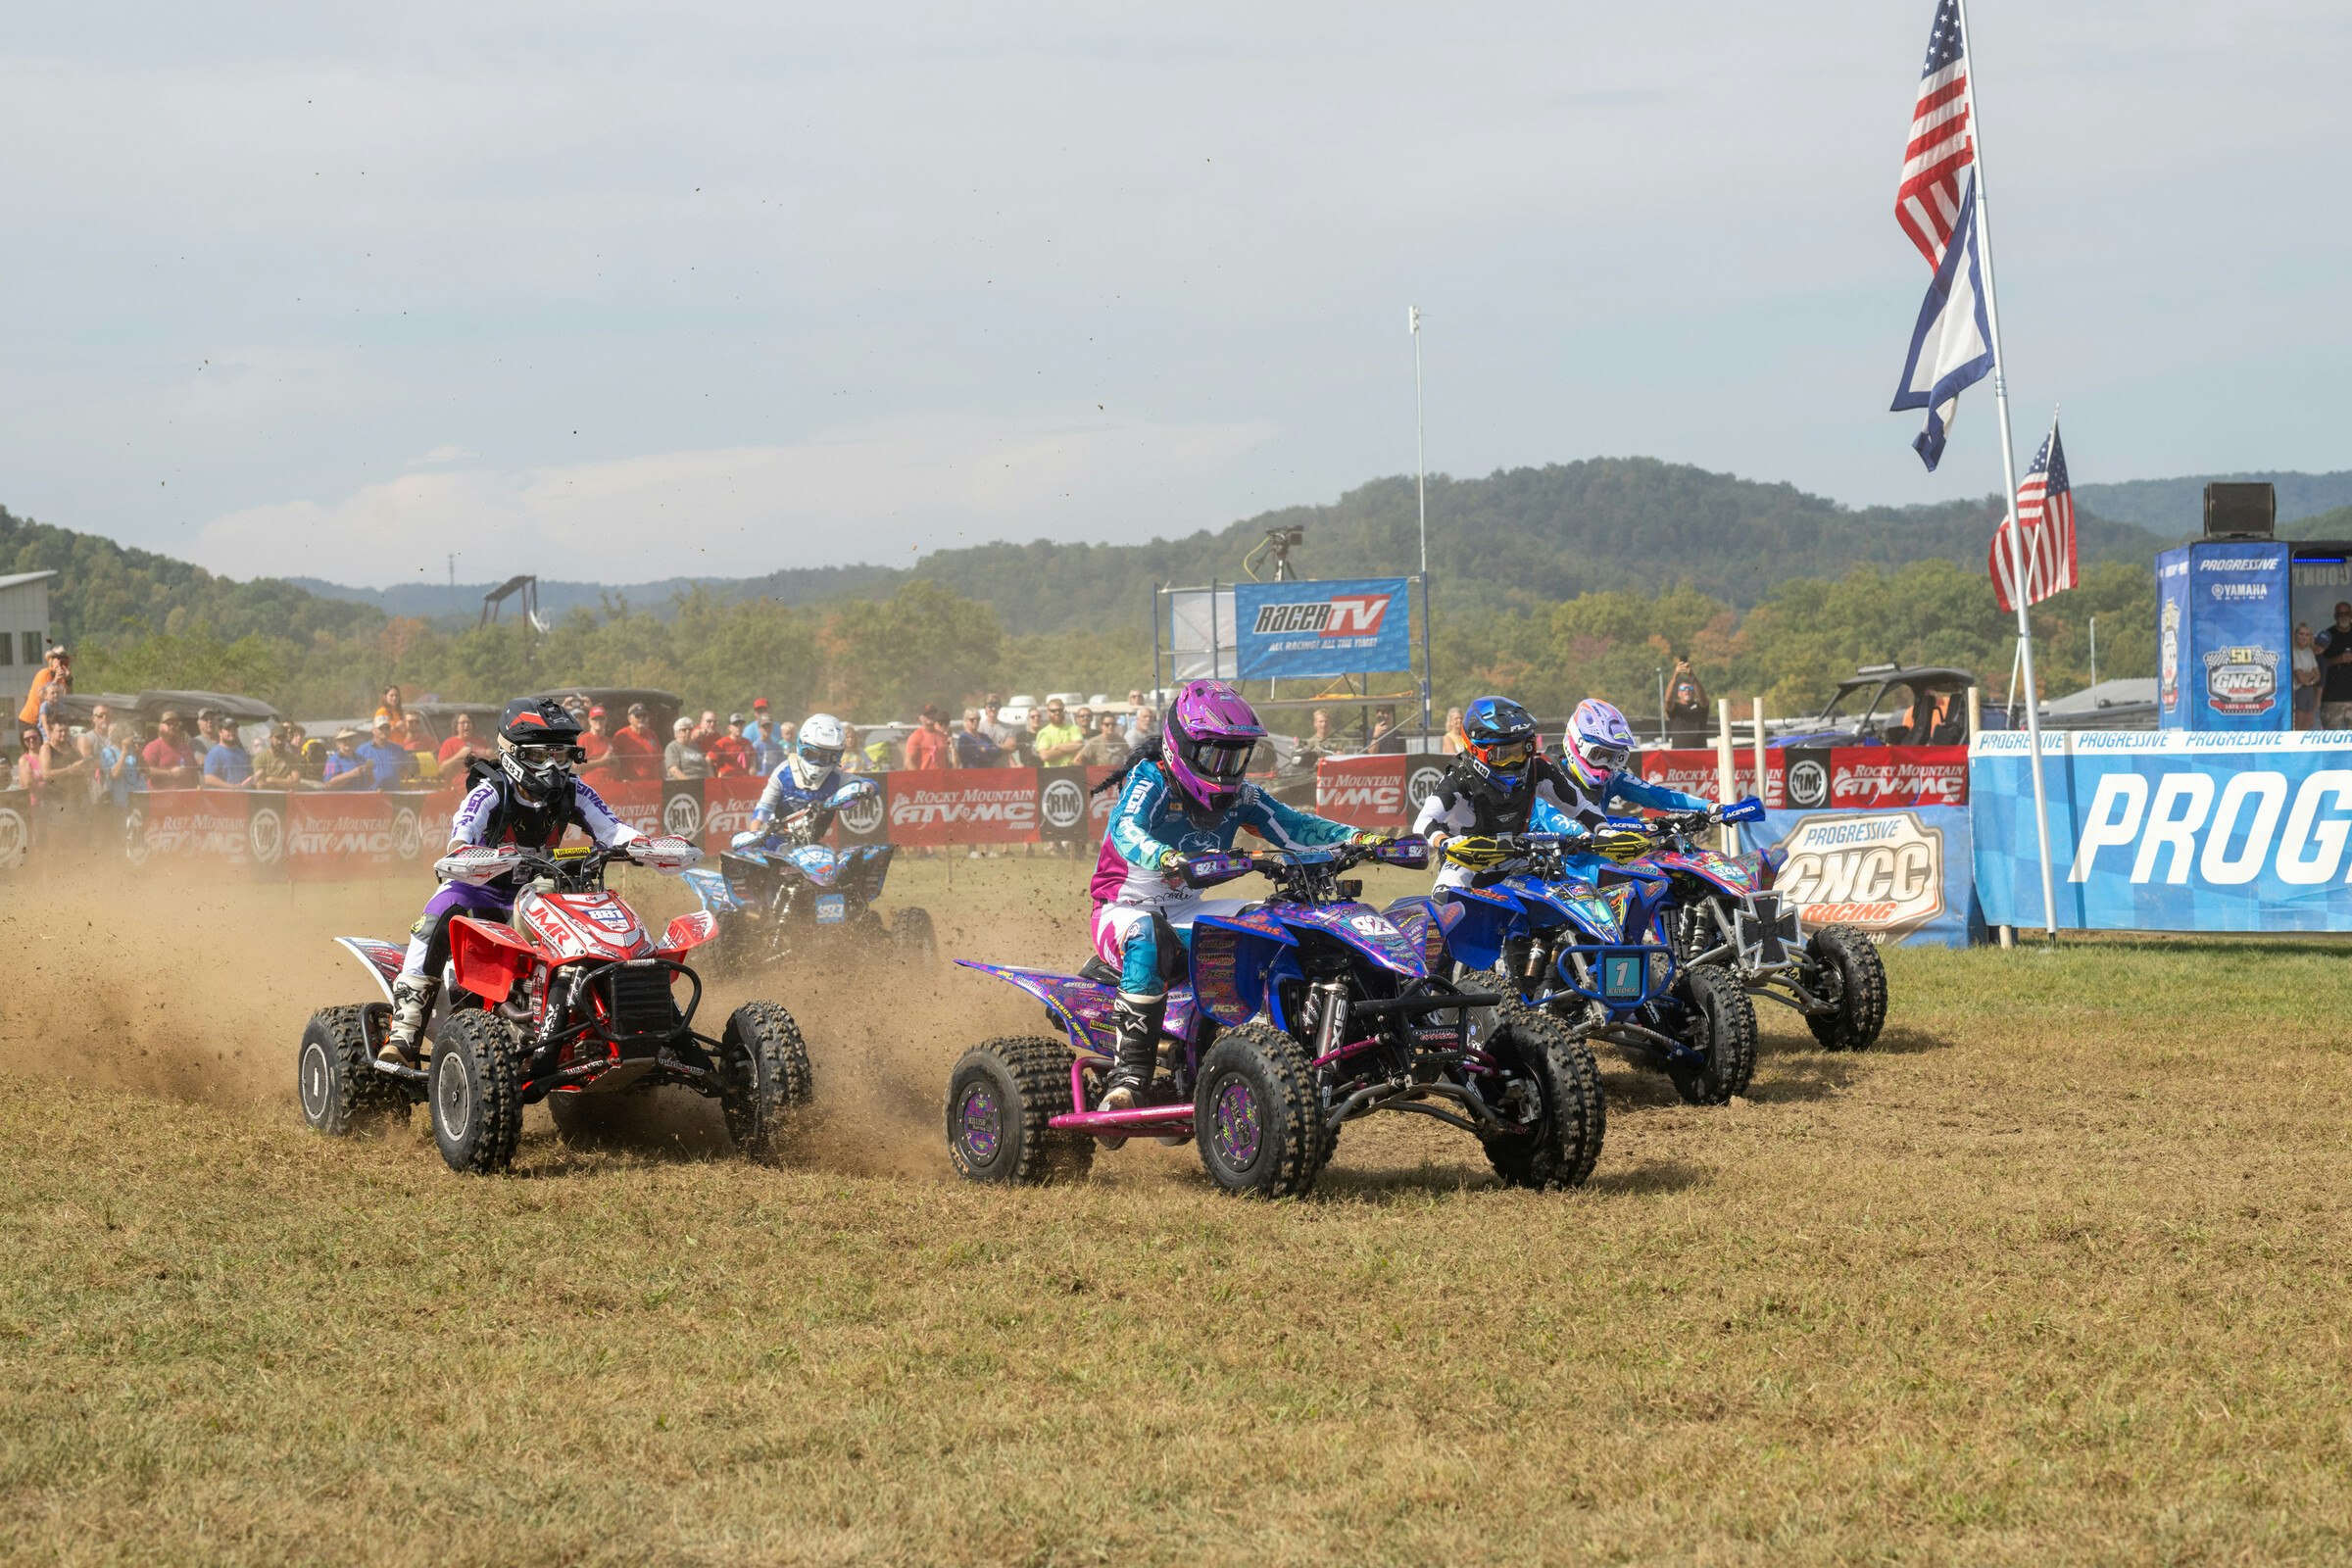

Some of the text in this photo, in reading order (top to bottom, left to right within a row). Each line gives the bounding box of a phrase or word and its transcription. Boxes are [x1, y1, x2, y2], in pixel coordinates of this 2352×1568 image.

[2200, 558, 2278, 571] PROGRESSIVE
[2225, 584, 2268, 596] YAMAHA
[1327, 599, 1390, 631] TV
[1269, 642, 1283, 652] ALL
[1286, 640, 1320, 651] RACING!
[1321, 640, 1336, 650] ALL
[1338, 639, 1351, 648] THE
[2230, 648, 2252, 663] 50
[2214, 673, 2270, 688] GNCC
[1510, 723, 1532, 732] FLY
[1980, 732, 2063, 750] PROGREIVE
[2079, 732, 2169, 749] PROGRESSIVE
[2185, 731, 2283, 748] PROGRESSIVE
[1667, 768, 1707, 781] ROCKY
[1852, 765, 1965, 778] ROCKY MOUNTAIN
[1335, 775, 1402, 788] MOUNTAIN
[914, 789, 1035, 803] ROCKY MOUNTAIN
[1804, 819, 1901, 847] PROGRESSIVE
[2067, 771, 2352, 885] PROG
[1619, 863, 1658, 875] KENDA
[1773, 842, 1932, 904] GNCC
[588, 909, 624, 919] 881
[1801, 902, 1898, 922] RACING
[526, 907, 571, 947] JMR
[1226, 919, 1281, 936] MAXXIS
[1350, 915, 1399, 936] 923
[1615, 961, 1630, 987] 1
